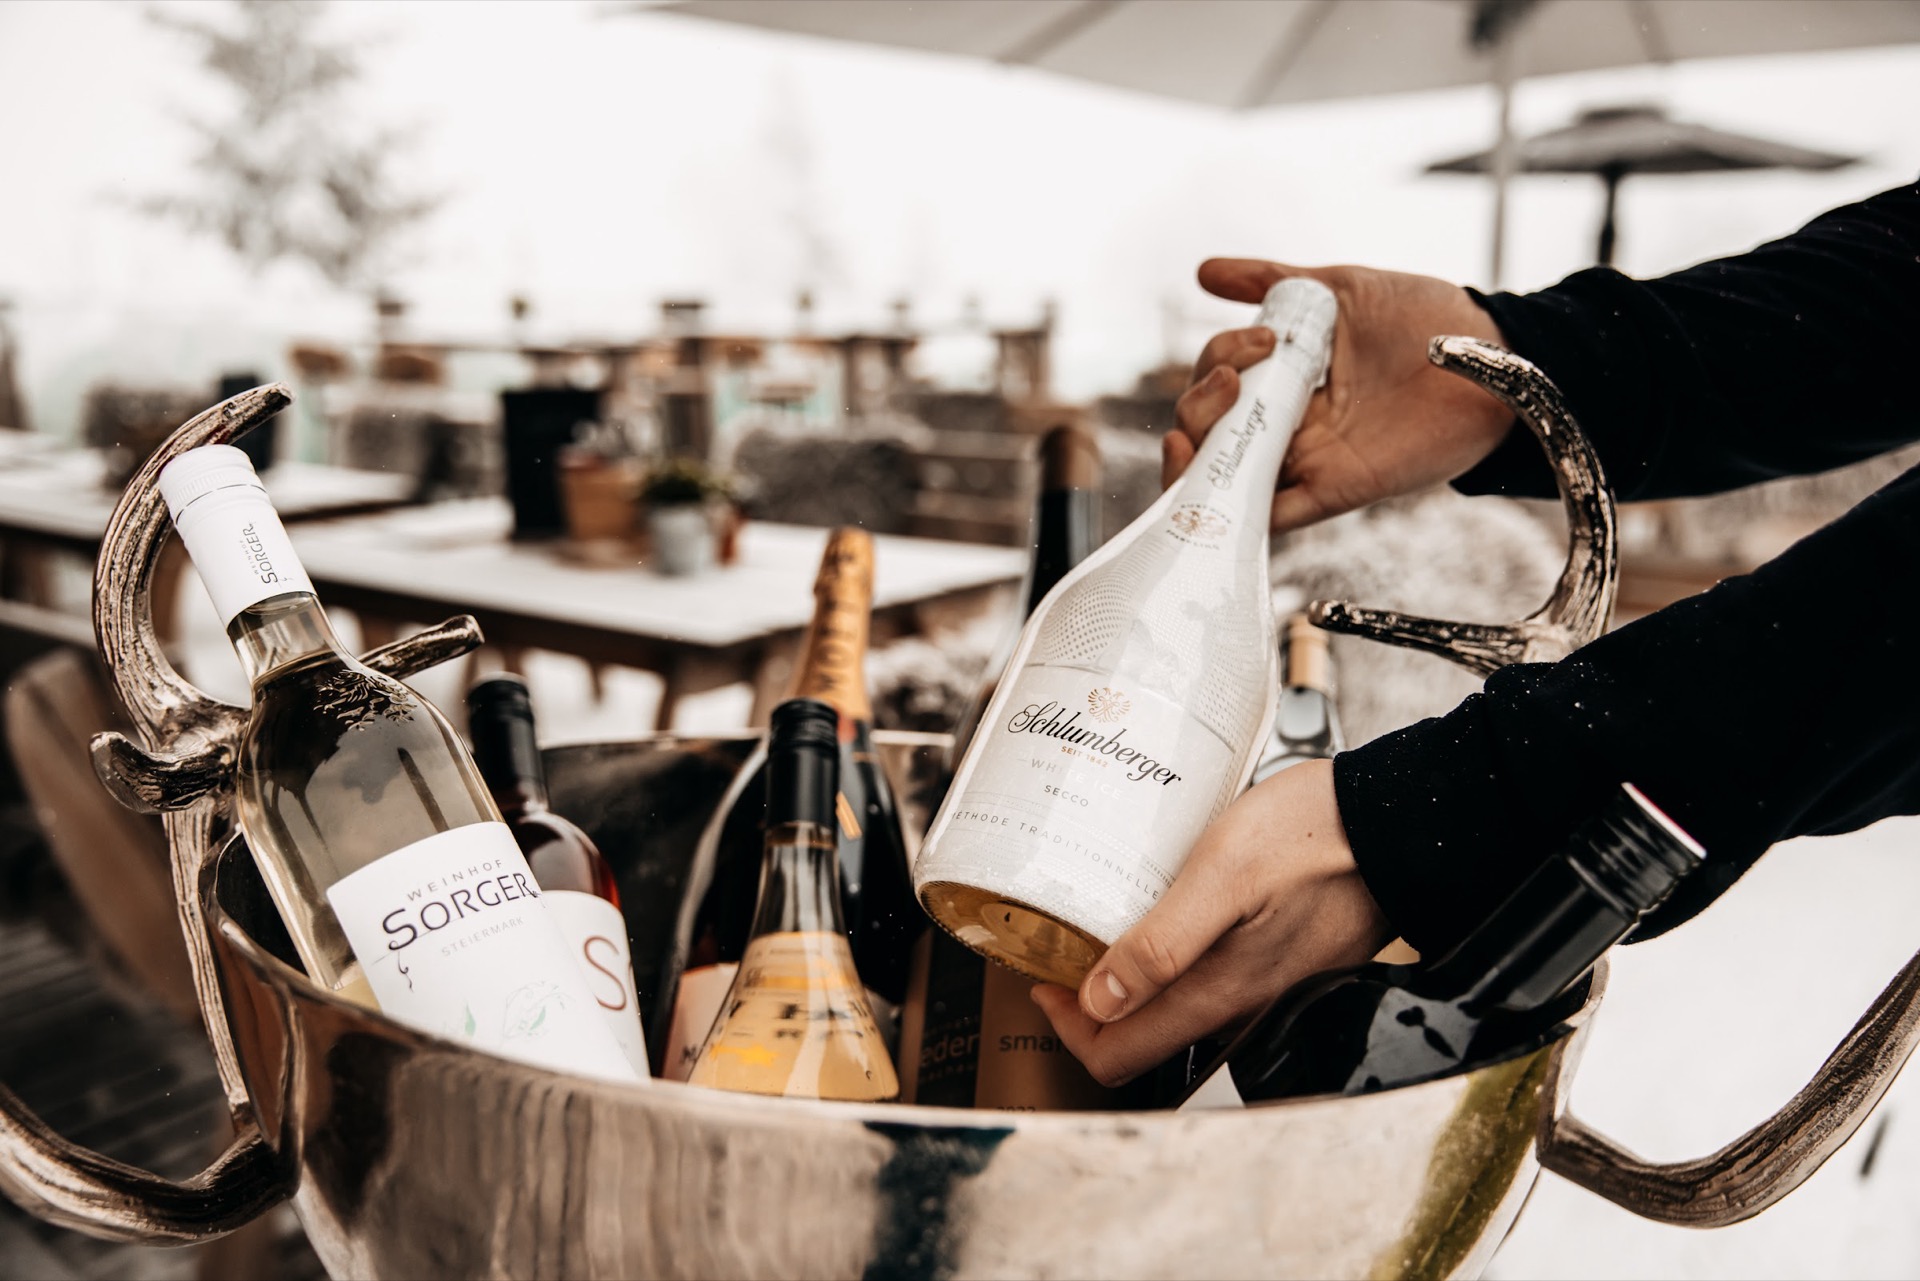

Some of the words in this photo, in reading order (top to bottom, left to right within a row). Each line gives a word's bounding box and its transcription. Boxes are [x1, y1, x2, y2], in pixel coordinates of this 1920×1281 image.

[1207, 397, 1266, 490] Schlumberger
[243, 522, 279, 584] SORGER
[1007, 700, 1182, 787] Schlumberger
[1061, 745, 1082, 758] SEIT
[1031, 758, 1087, 784] WHITE
[1044, 784, 1089, 807] SECCO
[407, 859, 503, 902] WEINHOF
[1019, 822, 1159, 900] TRADITIONNELLE
[382, 872, 539, 951] SORGER
[441, 916, 524, 957] STEIERMARK
